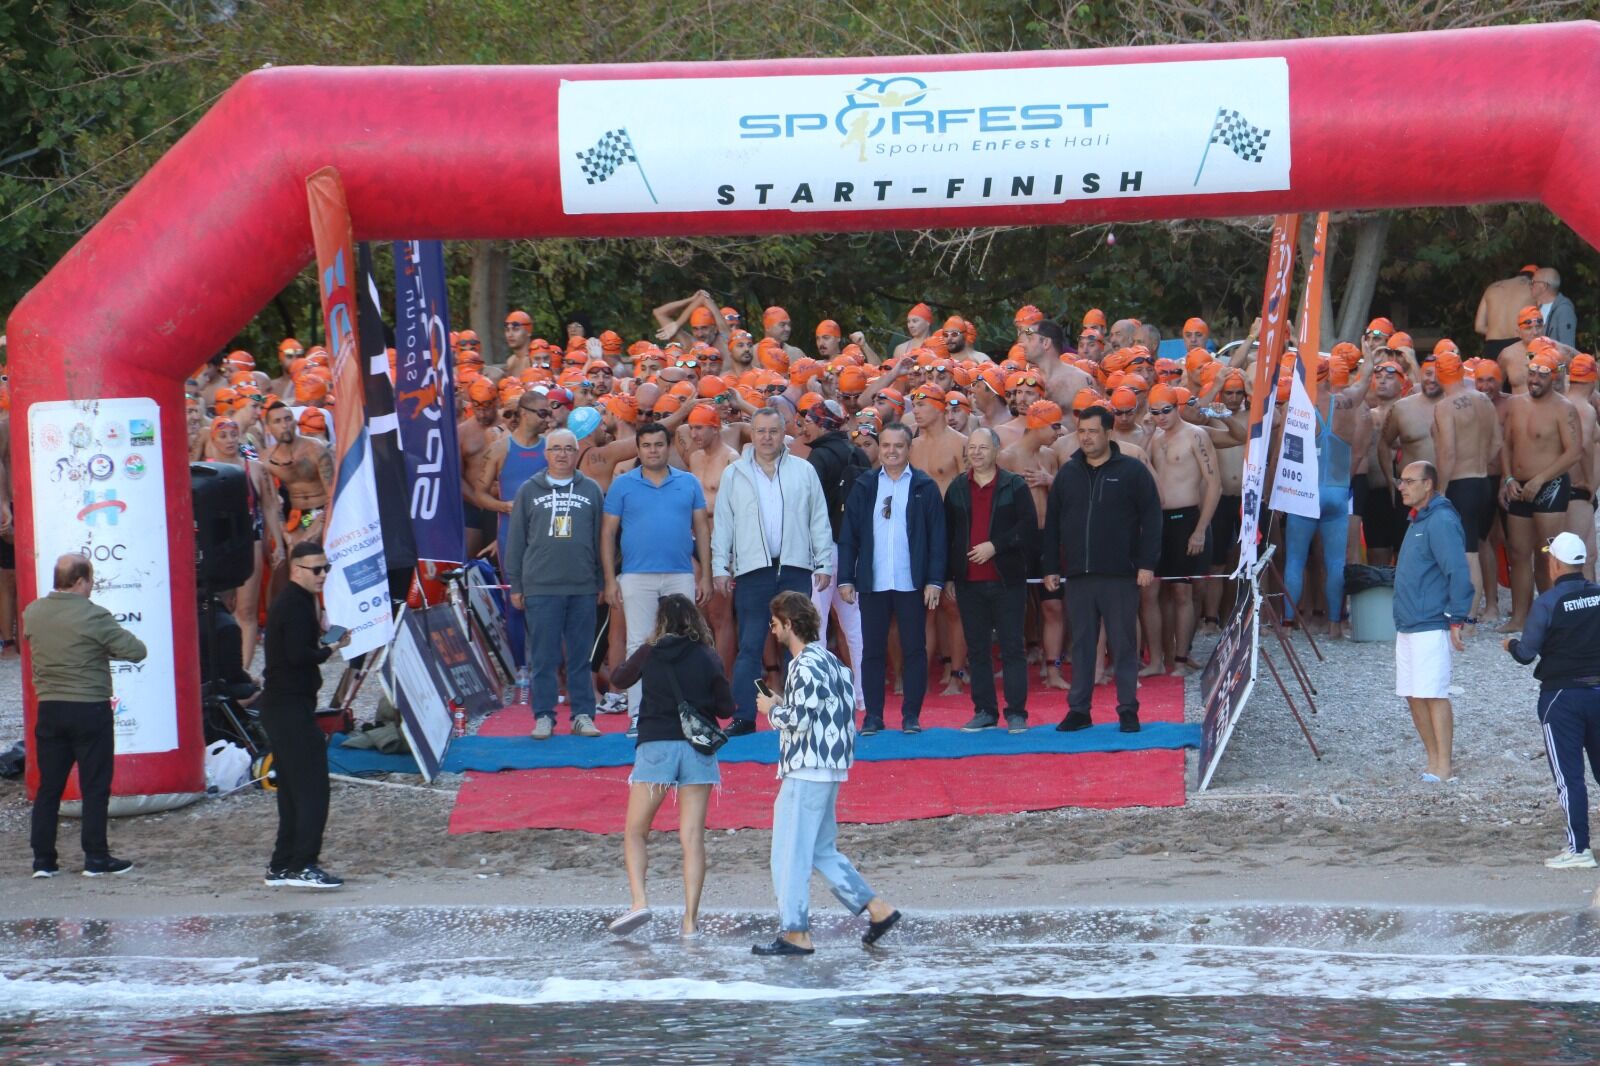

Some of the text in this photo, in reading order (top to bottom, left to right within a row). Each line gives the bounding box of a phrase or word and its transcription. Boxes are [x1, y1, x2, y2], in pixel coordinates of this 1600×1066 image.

[738, 102, 1110, 139] SPORFEST
[875, 132, 1111, 158] Sporun EnFest Hali
[81, 544, 127, 562] DOC
[1563, 596, 1600, 612] FETHİYESP
